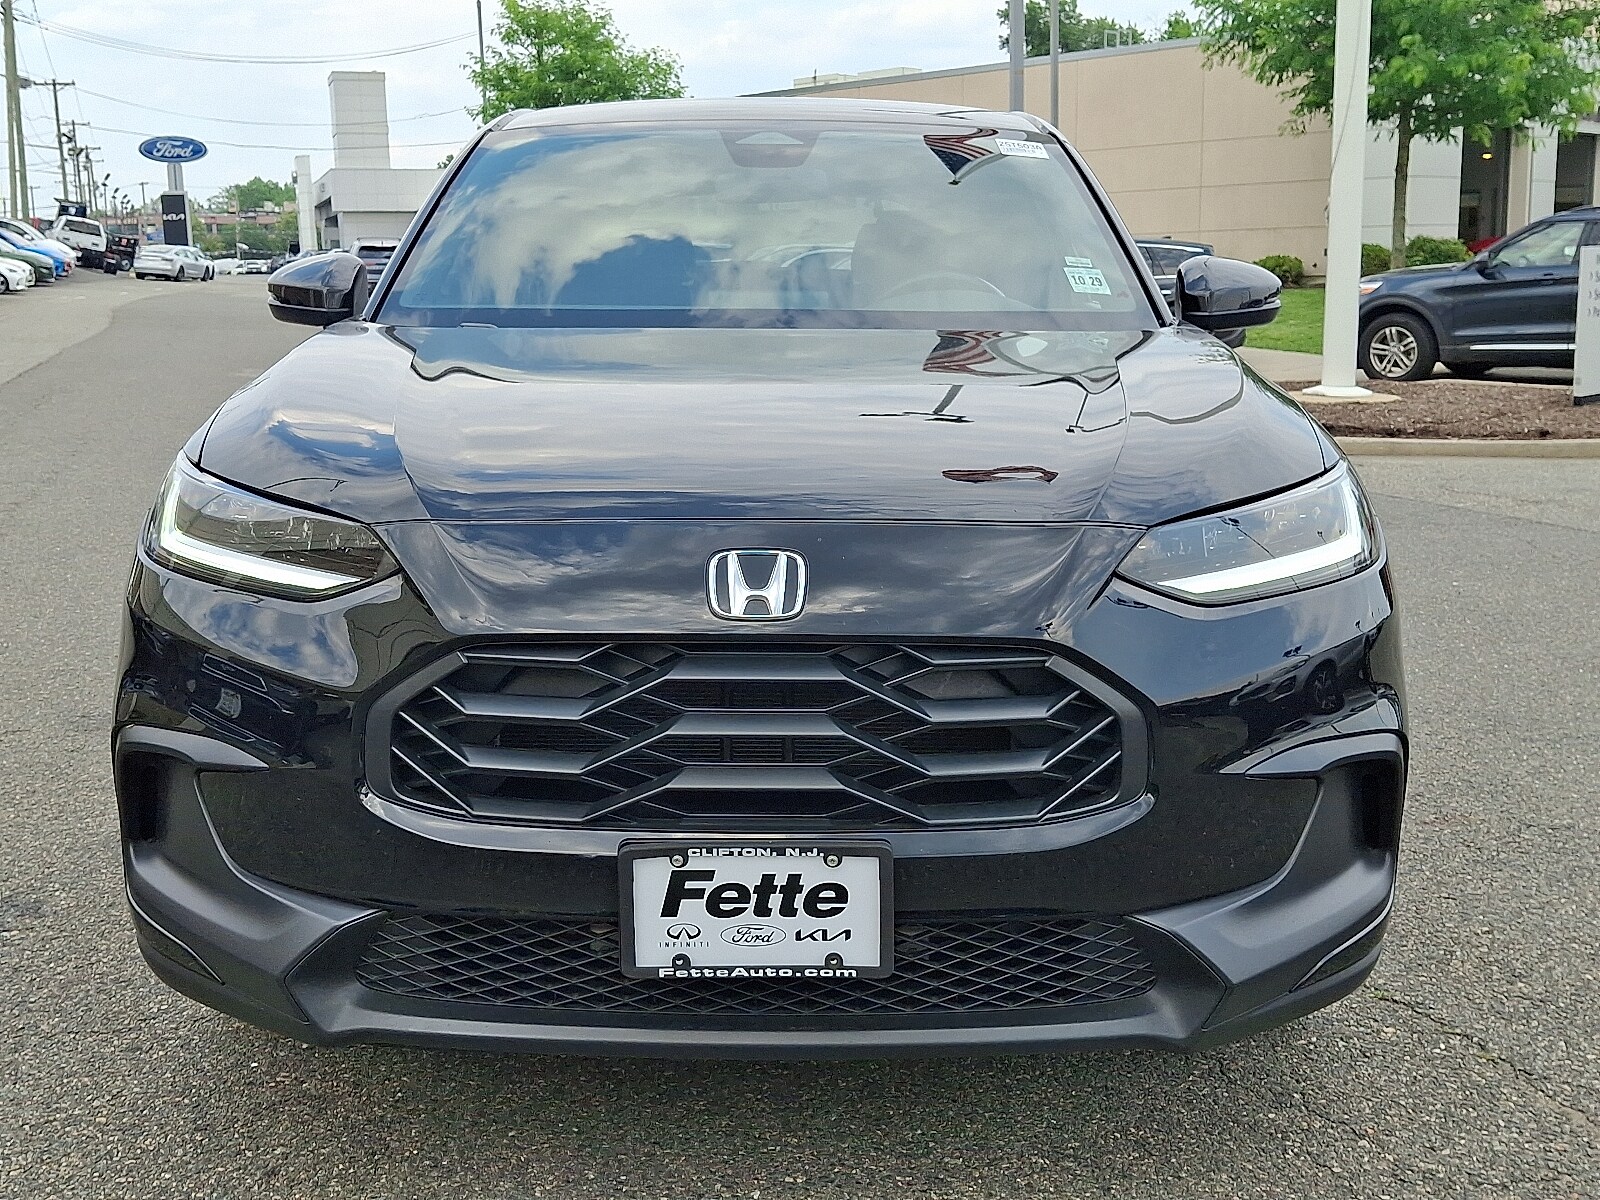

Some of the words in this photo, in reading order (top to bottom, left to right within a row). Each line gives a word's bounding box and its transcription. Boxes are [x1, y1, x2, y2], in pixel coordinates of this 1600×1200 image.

[153, 141, 193, 157] Ford
[1071, 275, 1085, 285] 10
[1089, 276, 1102, 286] 29
[785, 848, 824, 858] N.J.
[660, 870, 848, 918] Fette
[732, 927, 774, 943] Ford
[795, 929, 851, 941] KIA
[659, 967, 857, 978] FetteAuto.com
